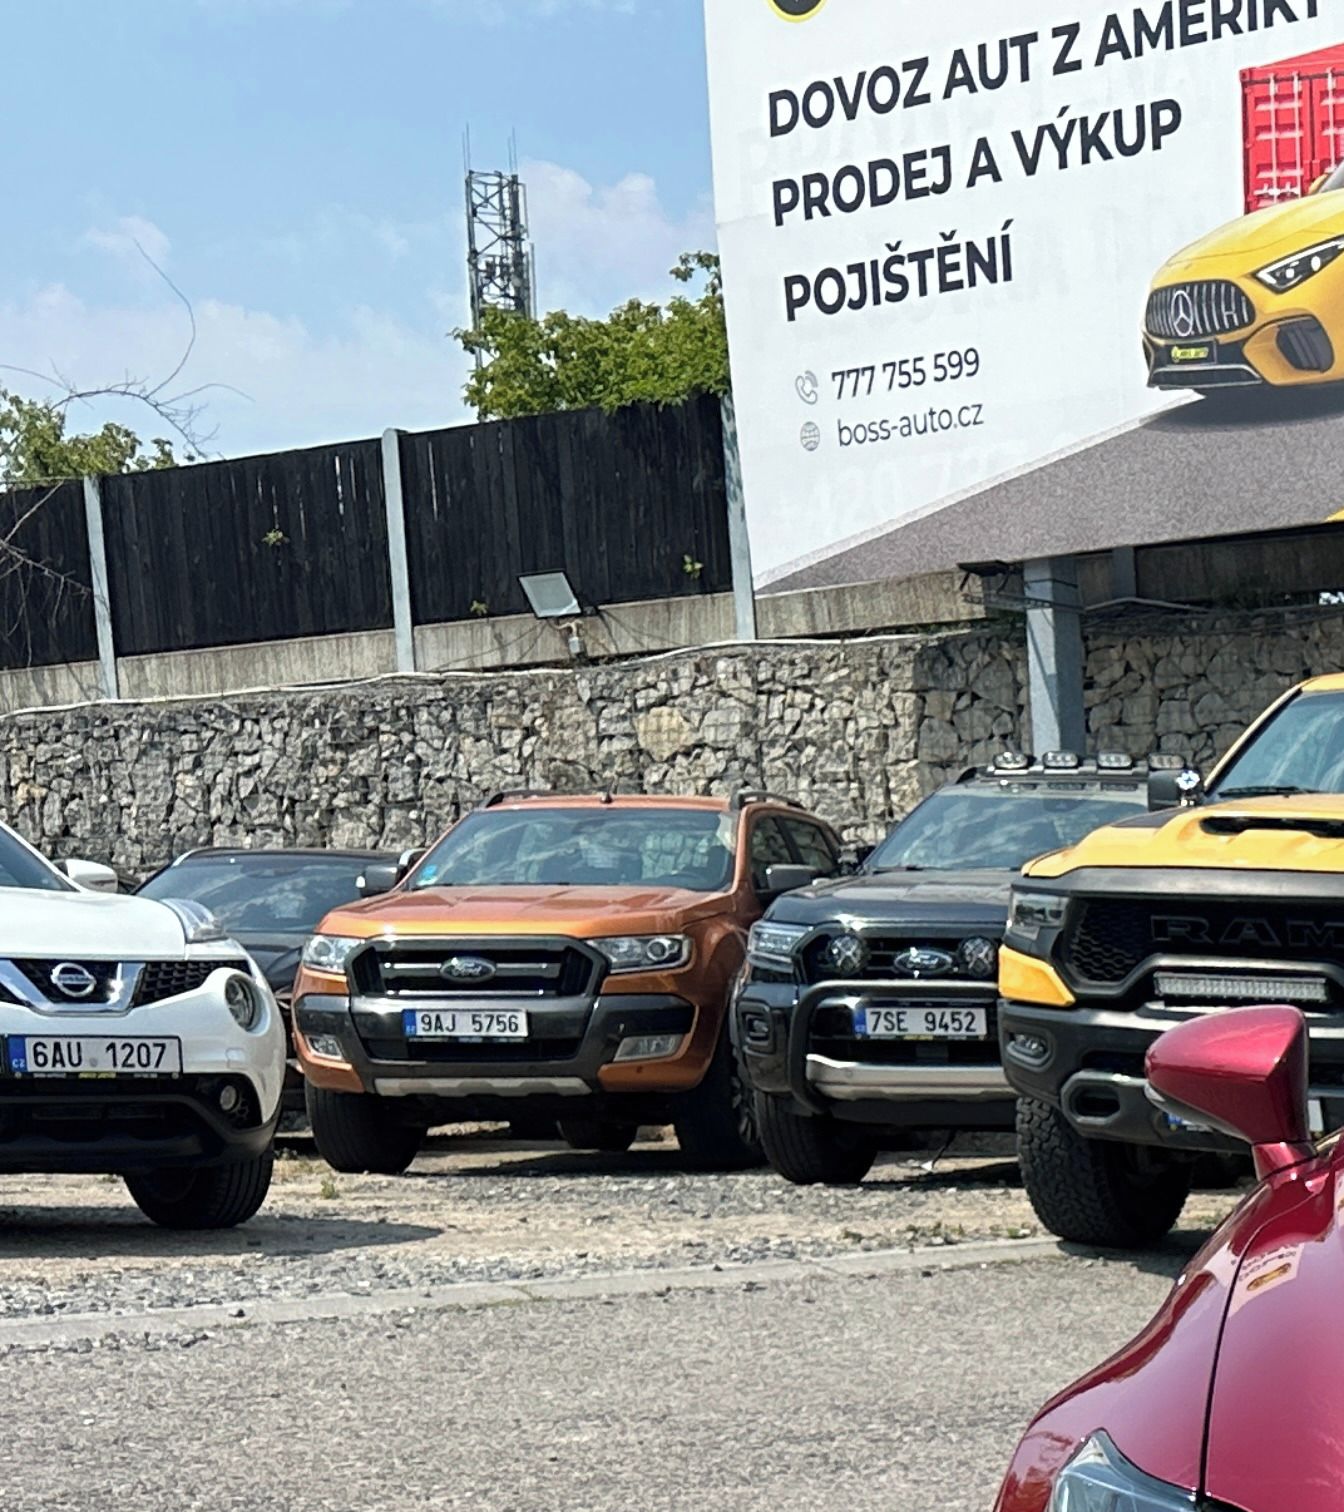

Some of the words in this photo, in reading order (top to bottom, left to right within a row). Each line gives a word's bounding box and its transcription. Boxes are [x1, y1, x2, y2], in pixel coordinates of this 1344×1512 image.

[769, 57, 931, 138] DOVOZ
[943, 31, 1039, 100] AUT
[1052, 22, 1082, 76] Z
[772, 144, 952, 227] PRODEJ
[966, 136, 1003, 188] A
[1011, 98, 1182, 177] VÝKUP
[783, 219, 1014, 322] POJIŠTĚNÍ
[831, 365, 876, 400] 777
[882, 356, 927, 391] 755
[933, 347, 980, 383] 599
[837, 403, 985, 448] boss-auto.cz
[420, 1013, 456, 1033] 9AJ
[471, 1014, 519, 1033] 5756
[870, 1010, 909, 1033] 7SE
[924, 1011, 977, 1033] 9452
[32, 1041, 83, 1068] 6AU
[105, 1042, 167, 1069] 1207
